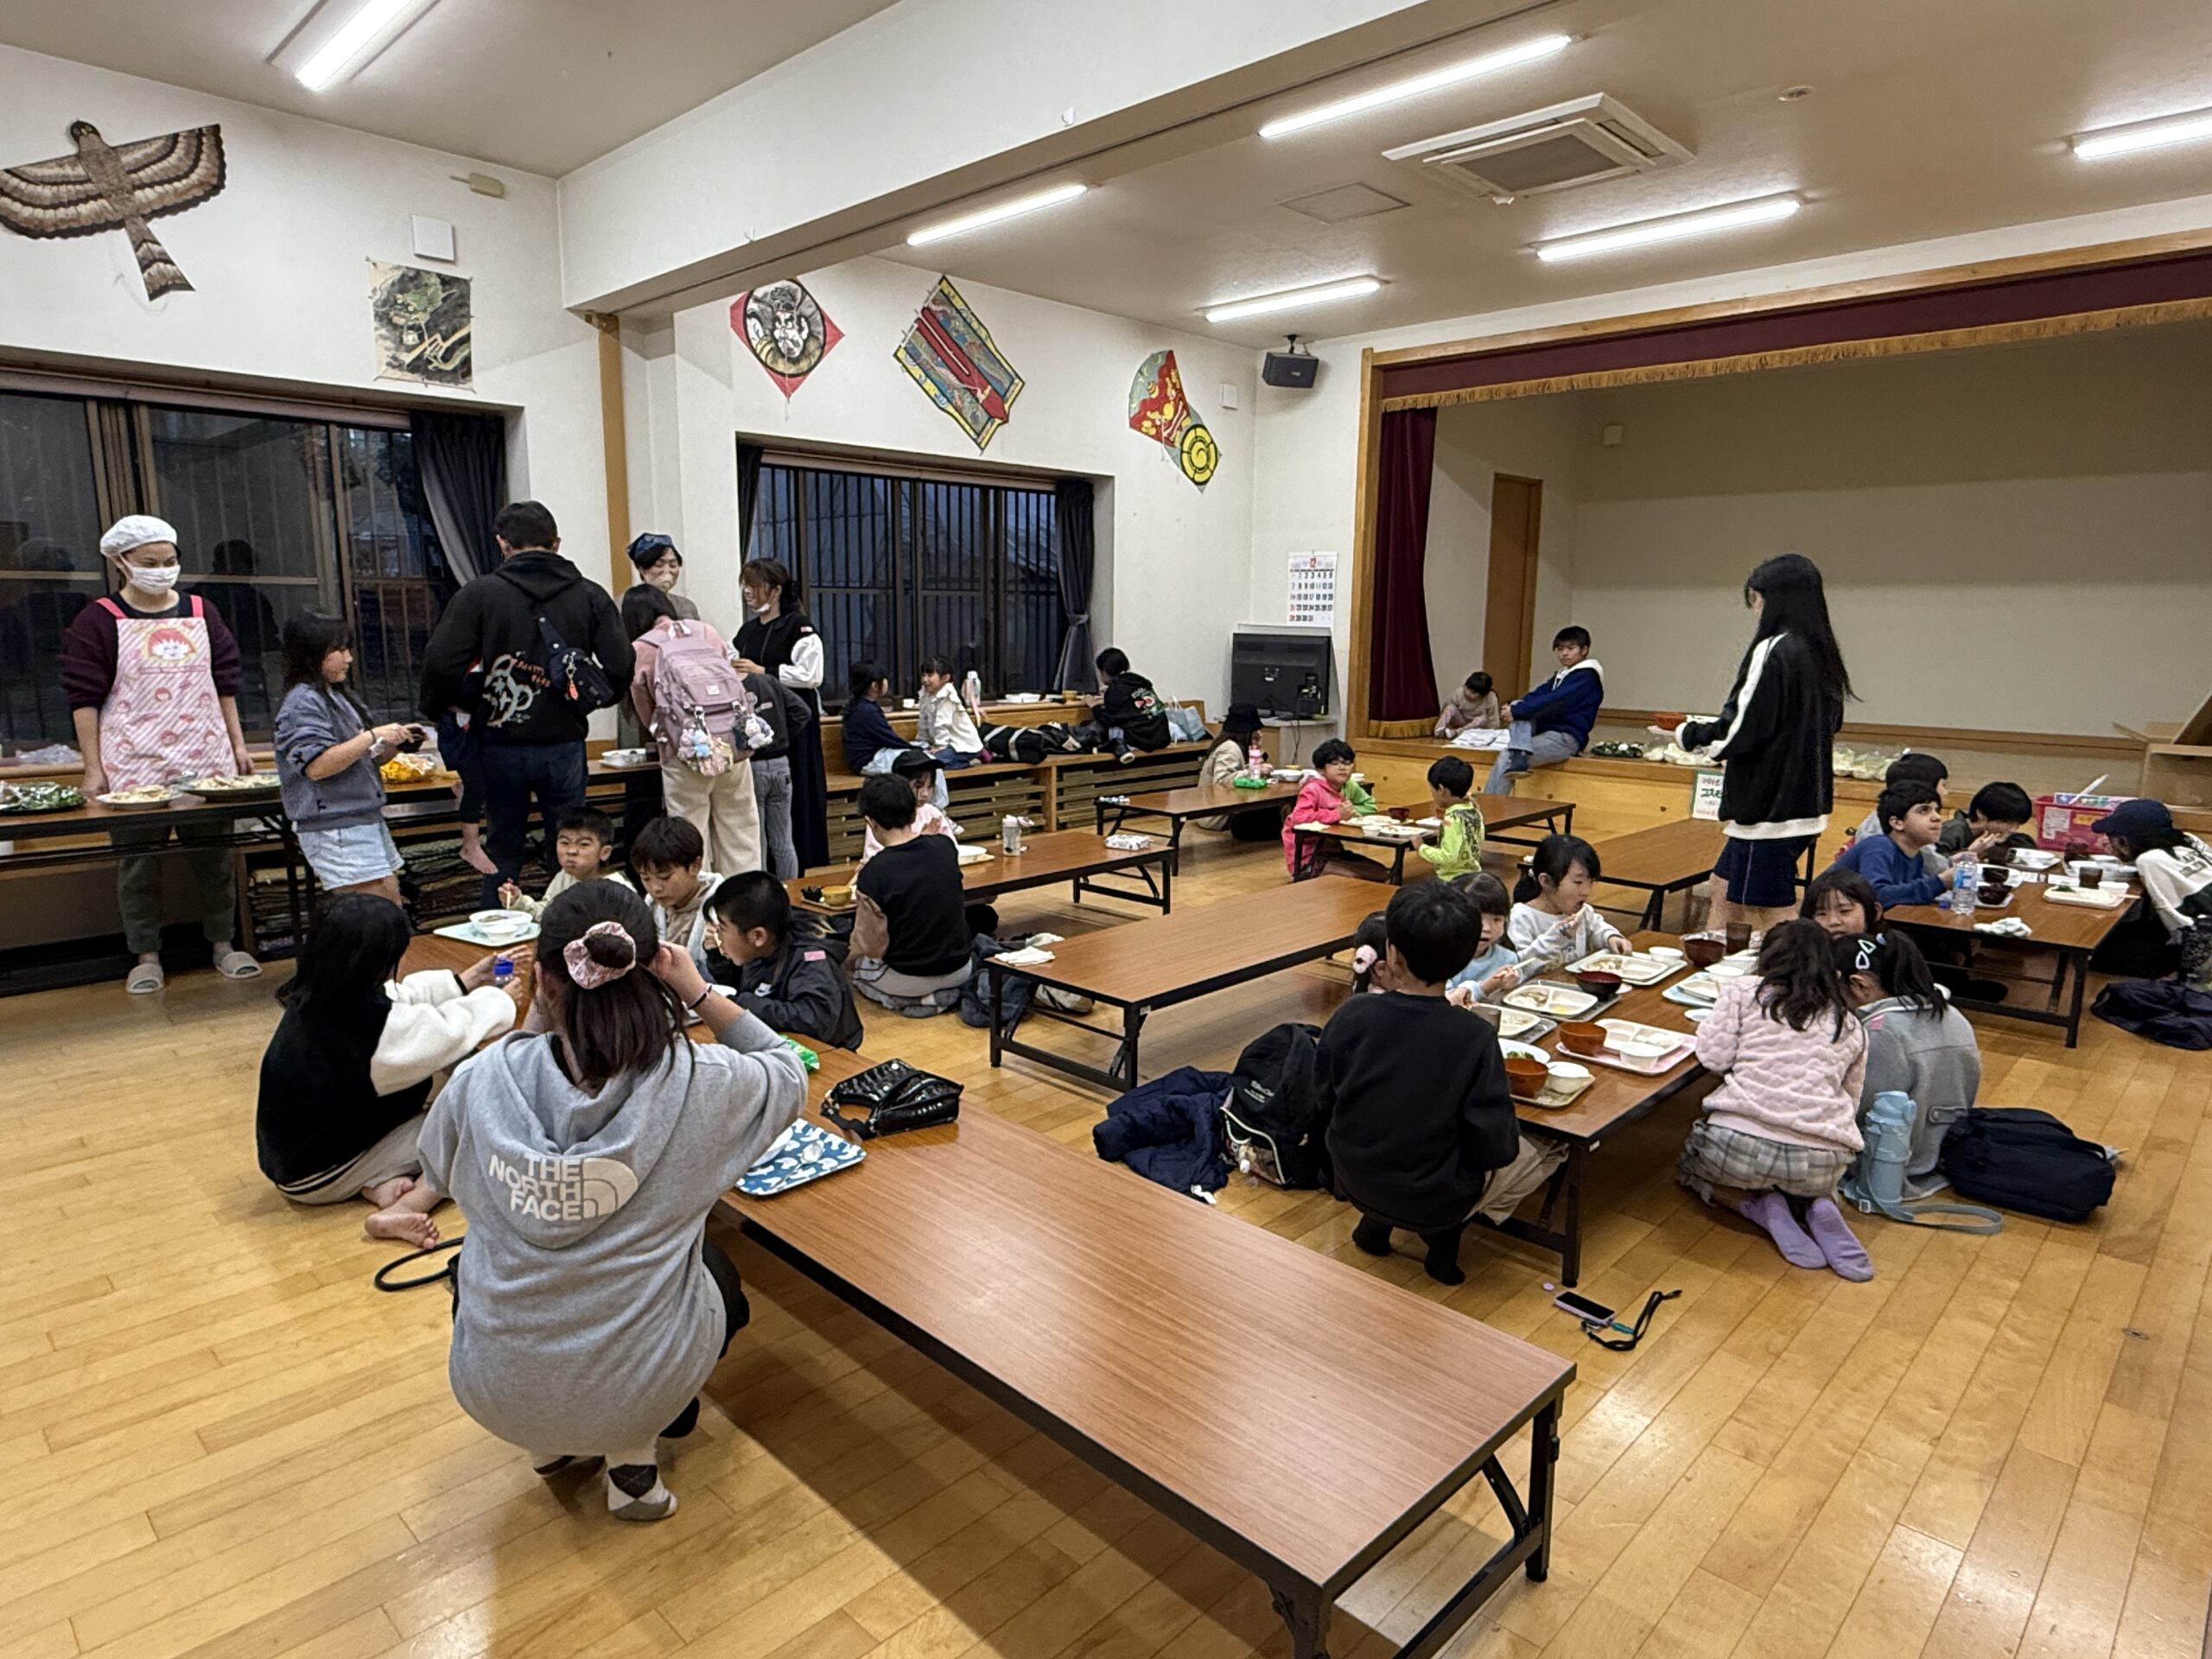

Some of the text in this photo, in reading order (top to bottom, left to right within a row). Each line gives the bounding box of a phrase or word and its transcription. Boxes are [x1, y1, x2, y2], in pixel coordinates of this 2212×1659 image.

[488, 1154, 582, 1202] NORTH
[524, 1153, 582, 1181] THE
[510, 1189, 582, 1222] FACE
